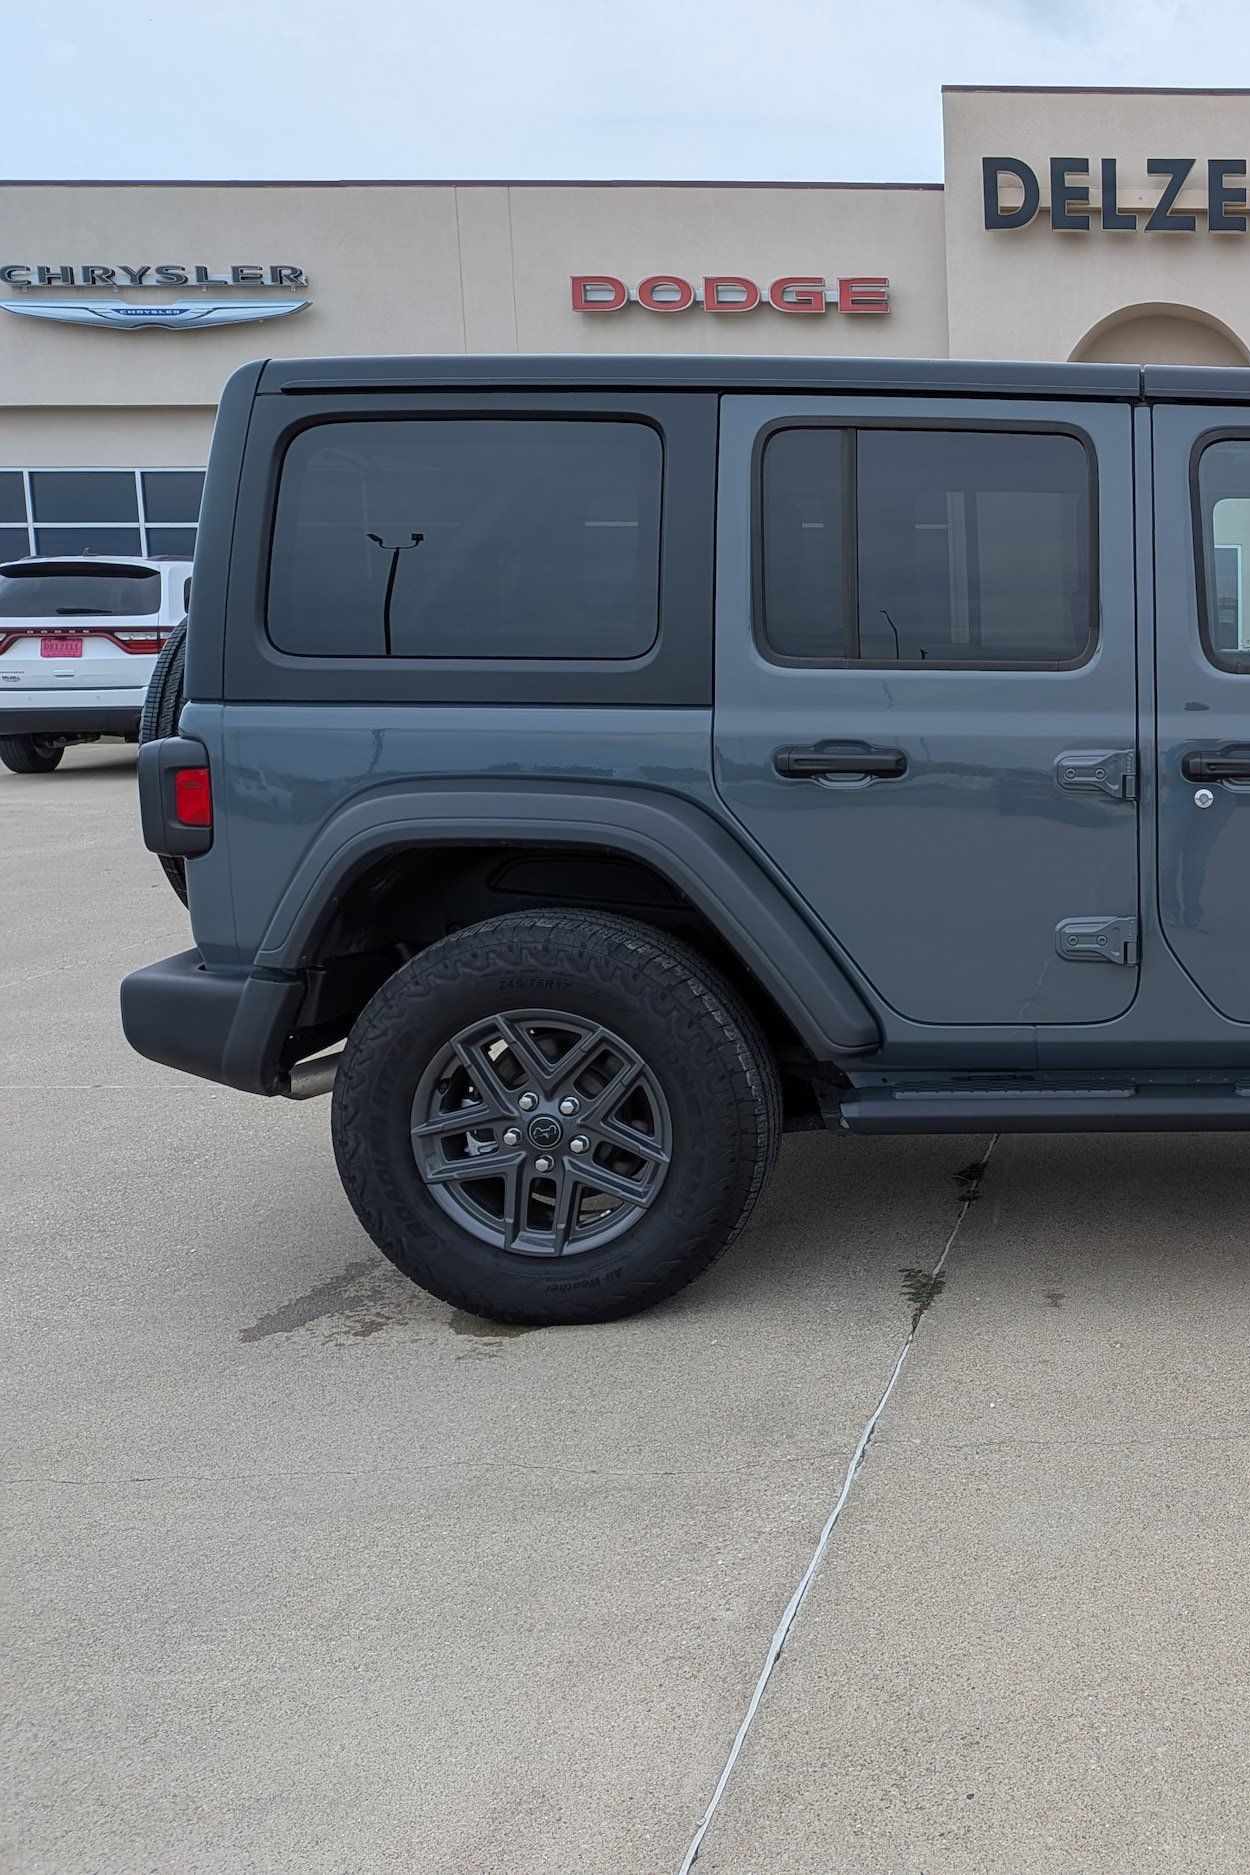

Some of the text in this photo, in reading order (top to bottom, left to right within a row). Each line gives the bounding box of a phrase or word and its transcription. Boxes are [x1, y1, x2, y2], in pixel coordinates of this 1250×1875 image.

[0, 265, 305, 286] CHRYSLER
[570, 275, 890, 314] DODGE
[498, 977, 572, 991] 245/75R17
